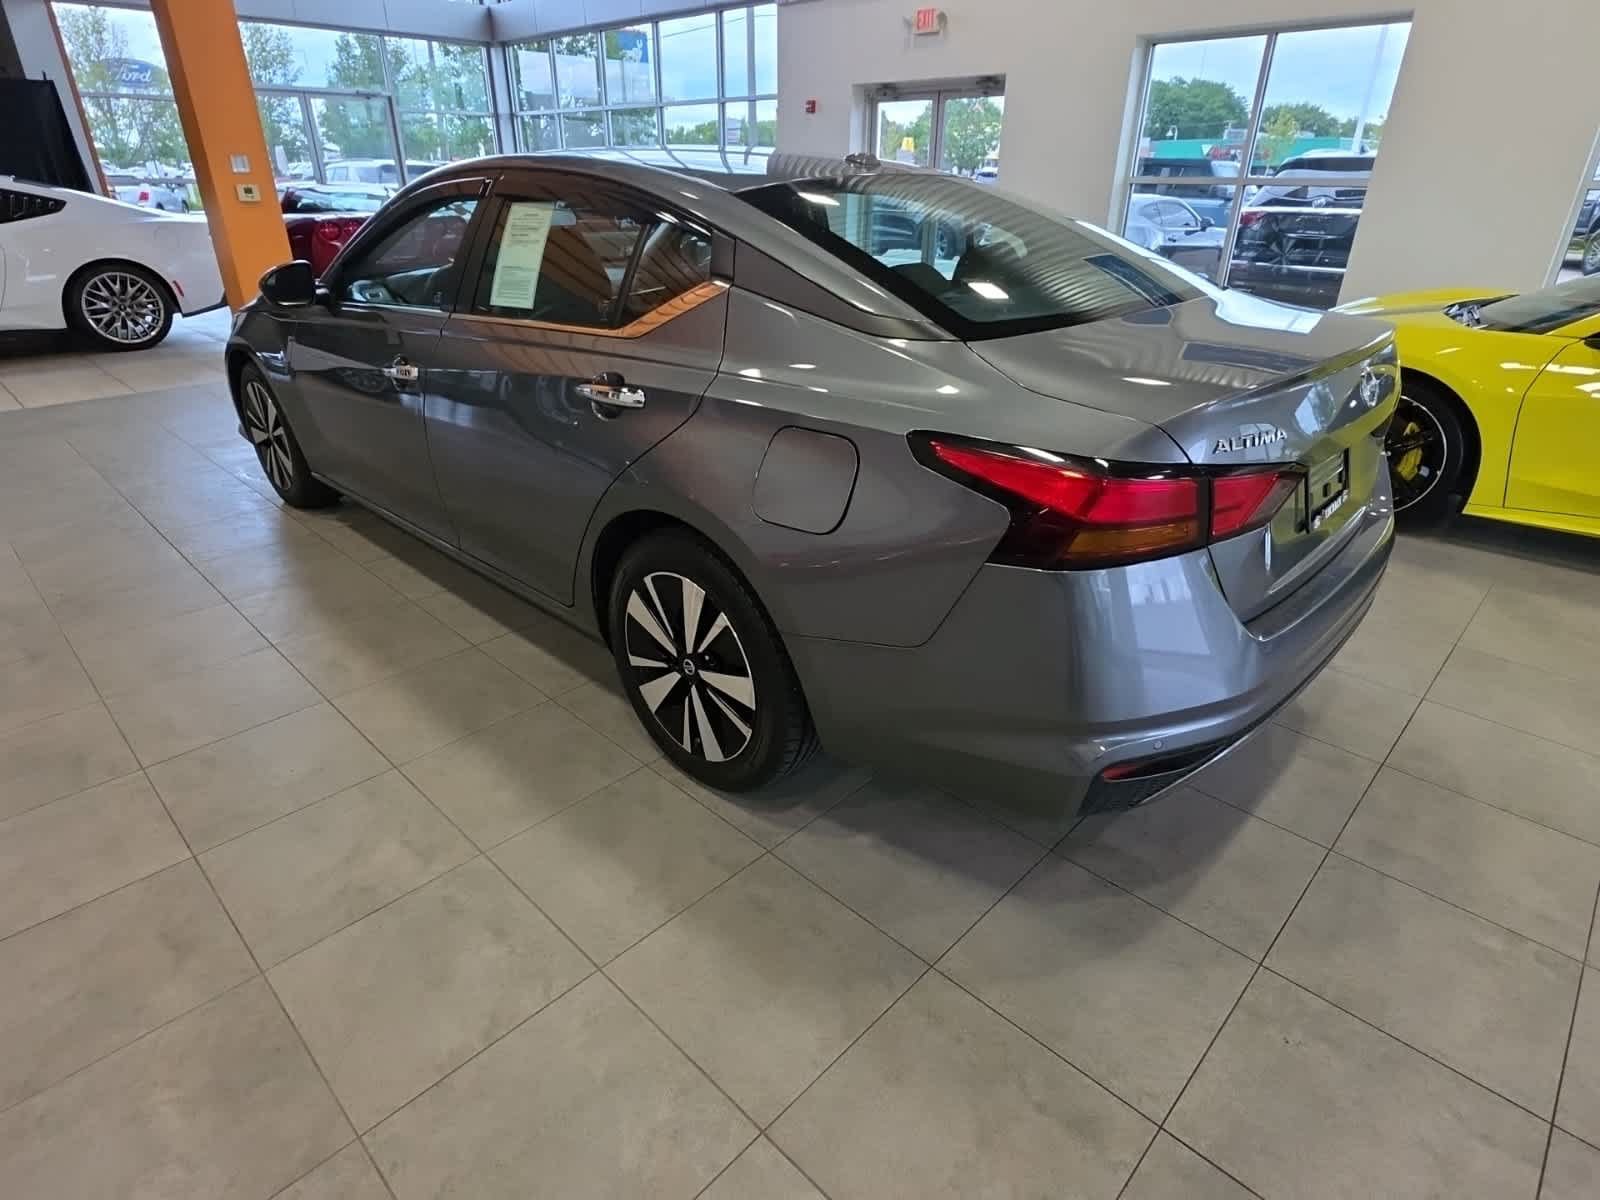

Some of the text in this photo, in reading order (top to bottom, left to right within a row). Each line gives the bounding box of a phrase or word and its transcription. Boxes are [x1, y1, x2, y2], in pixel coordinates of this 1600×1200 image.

[917, 10, 936, 30] EXIT
[114, 63, 152, 82] Ford
[1213, 427, 1288, 455] ALTIMA
